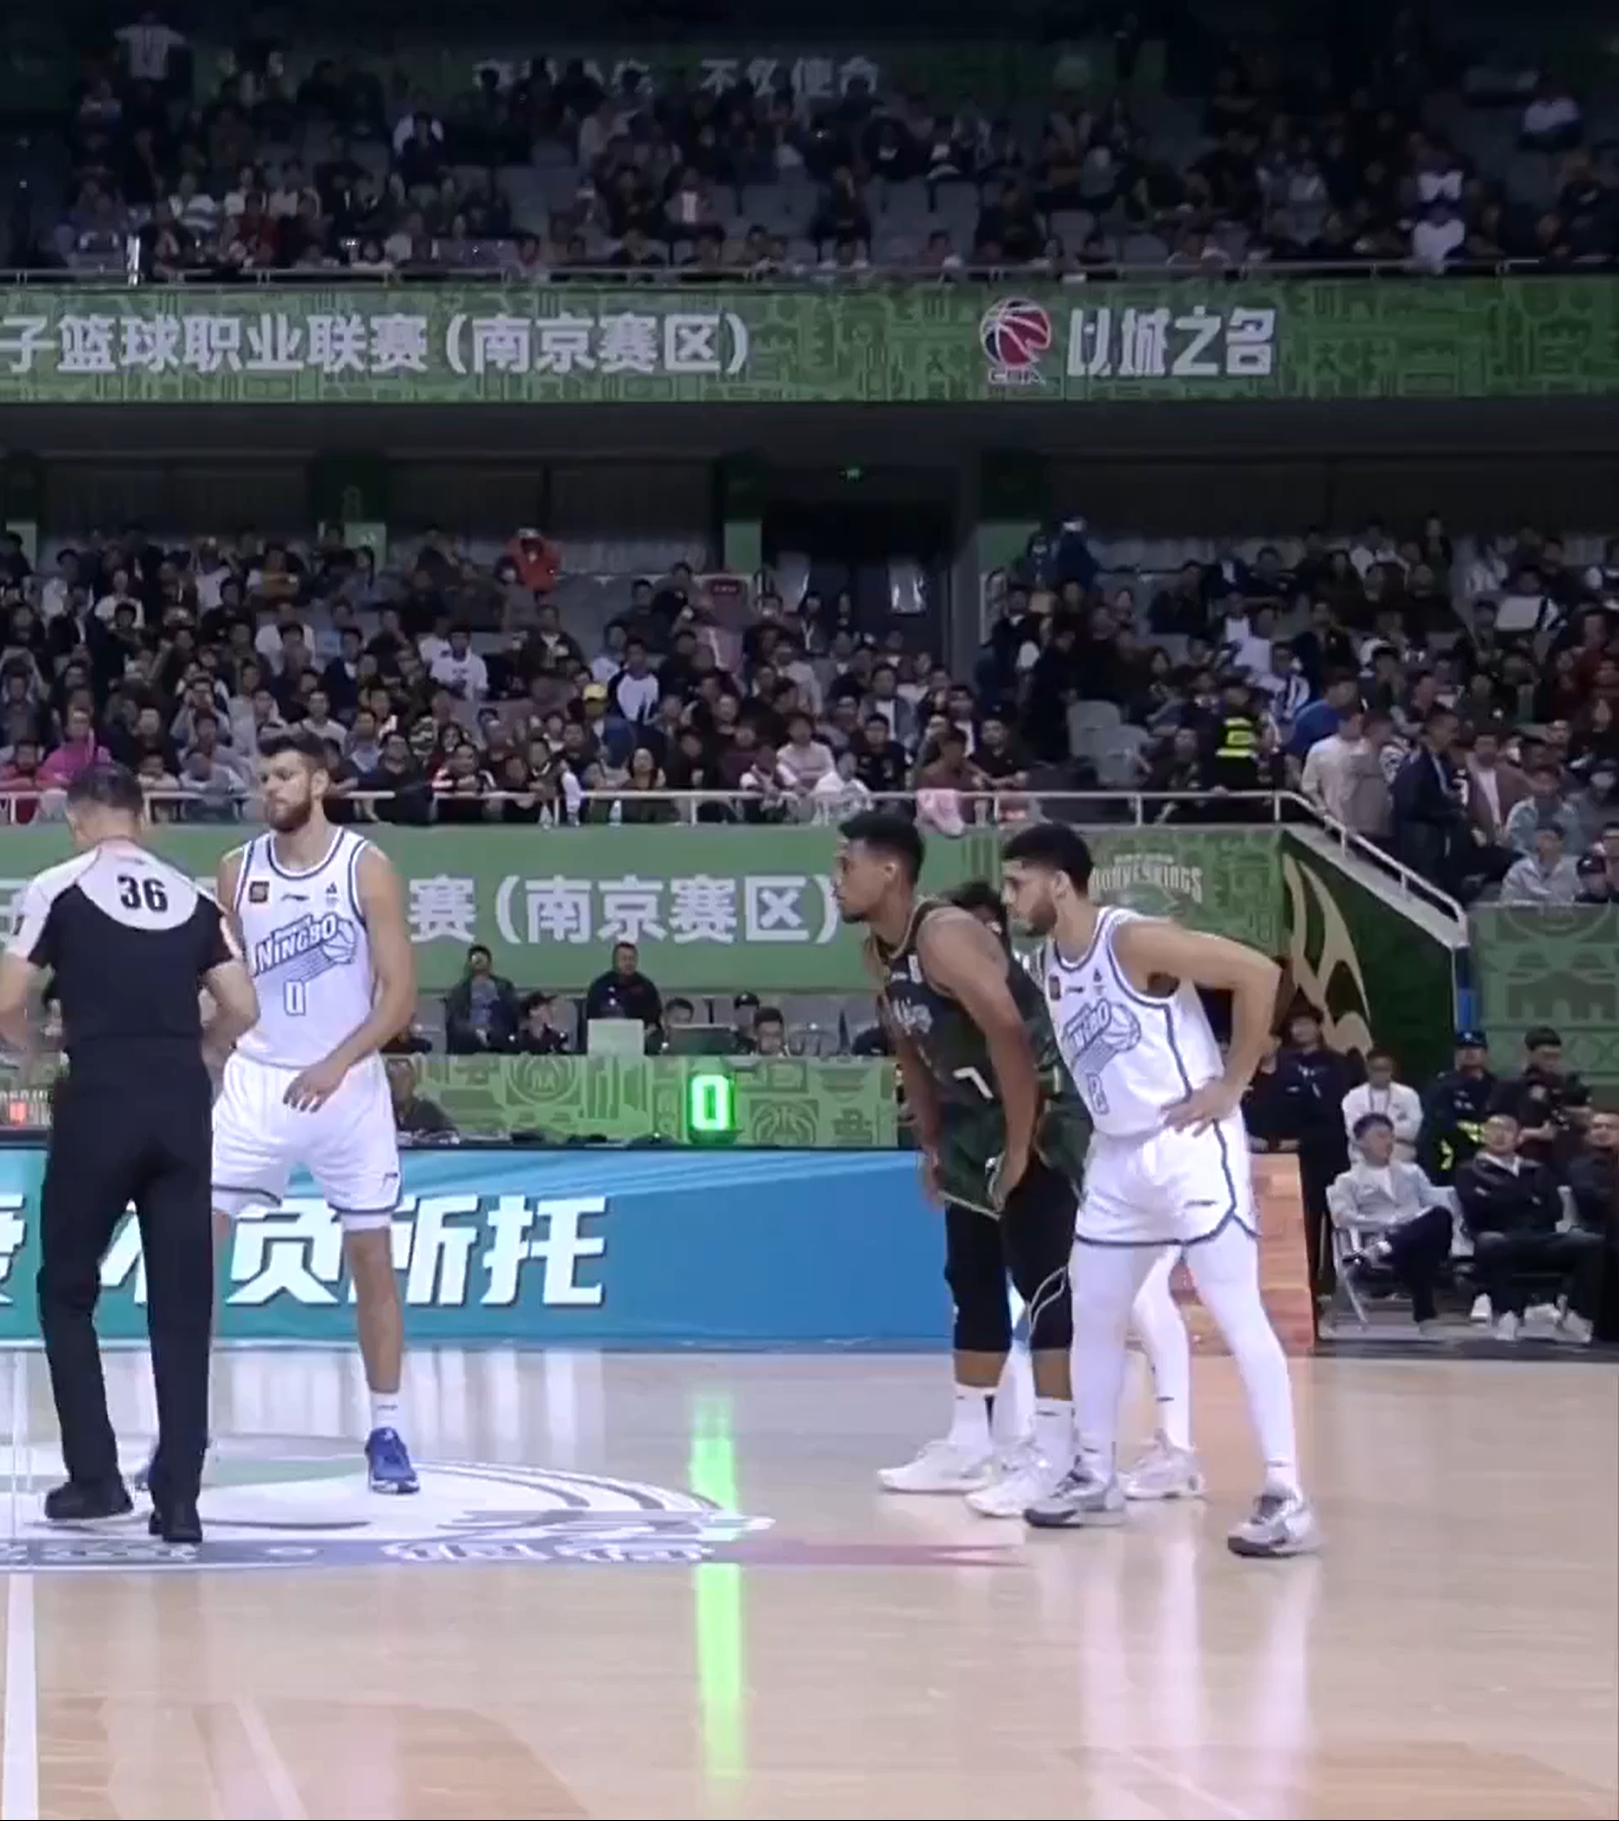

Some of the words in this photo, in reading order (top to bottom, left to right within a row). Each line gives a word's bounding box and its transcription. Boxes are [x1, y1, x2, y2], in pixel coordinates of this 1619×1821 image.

[1067, 305, 1276, 376] 以城之名
[117, 875, 168, 913] 36
[254, 911, 339, 975] NINGBO
[284, 980, 307, 1017] 0
[691, 1074, 730, 1131] 0
